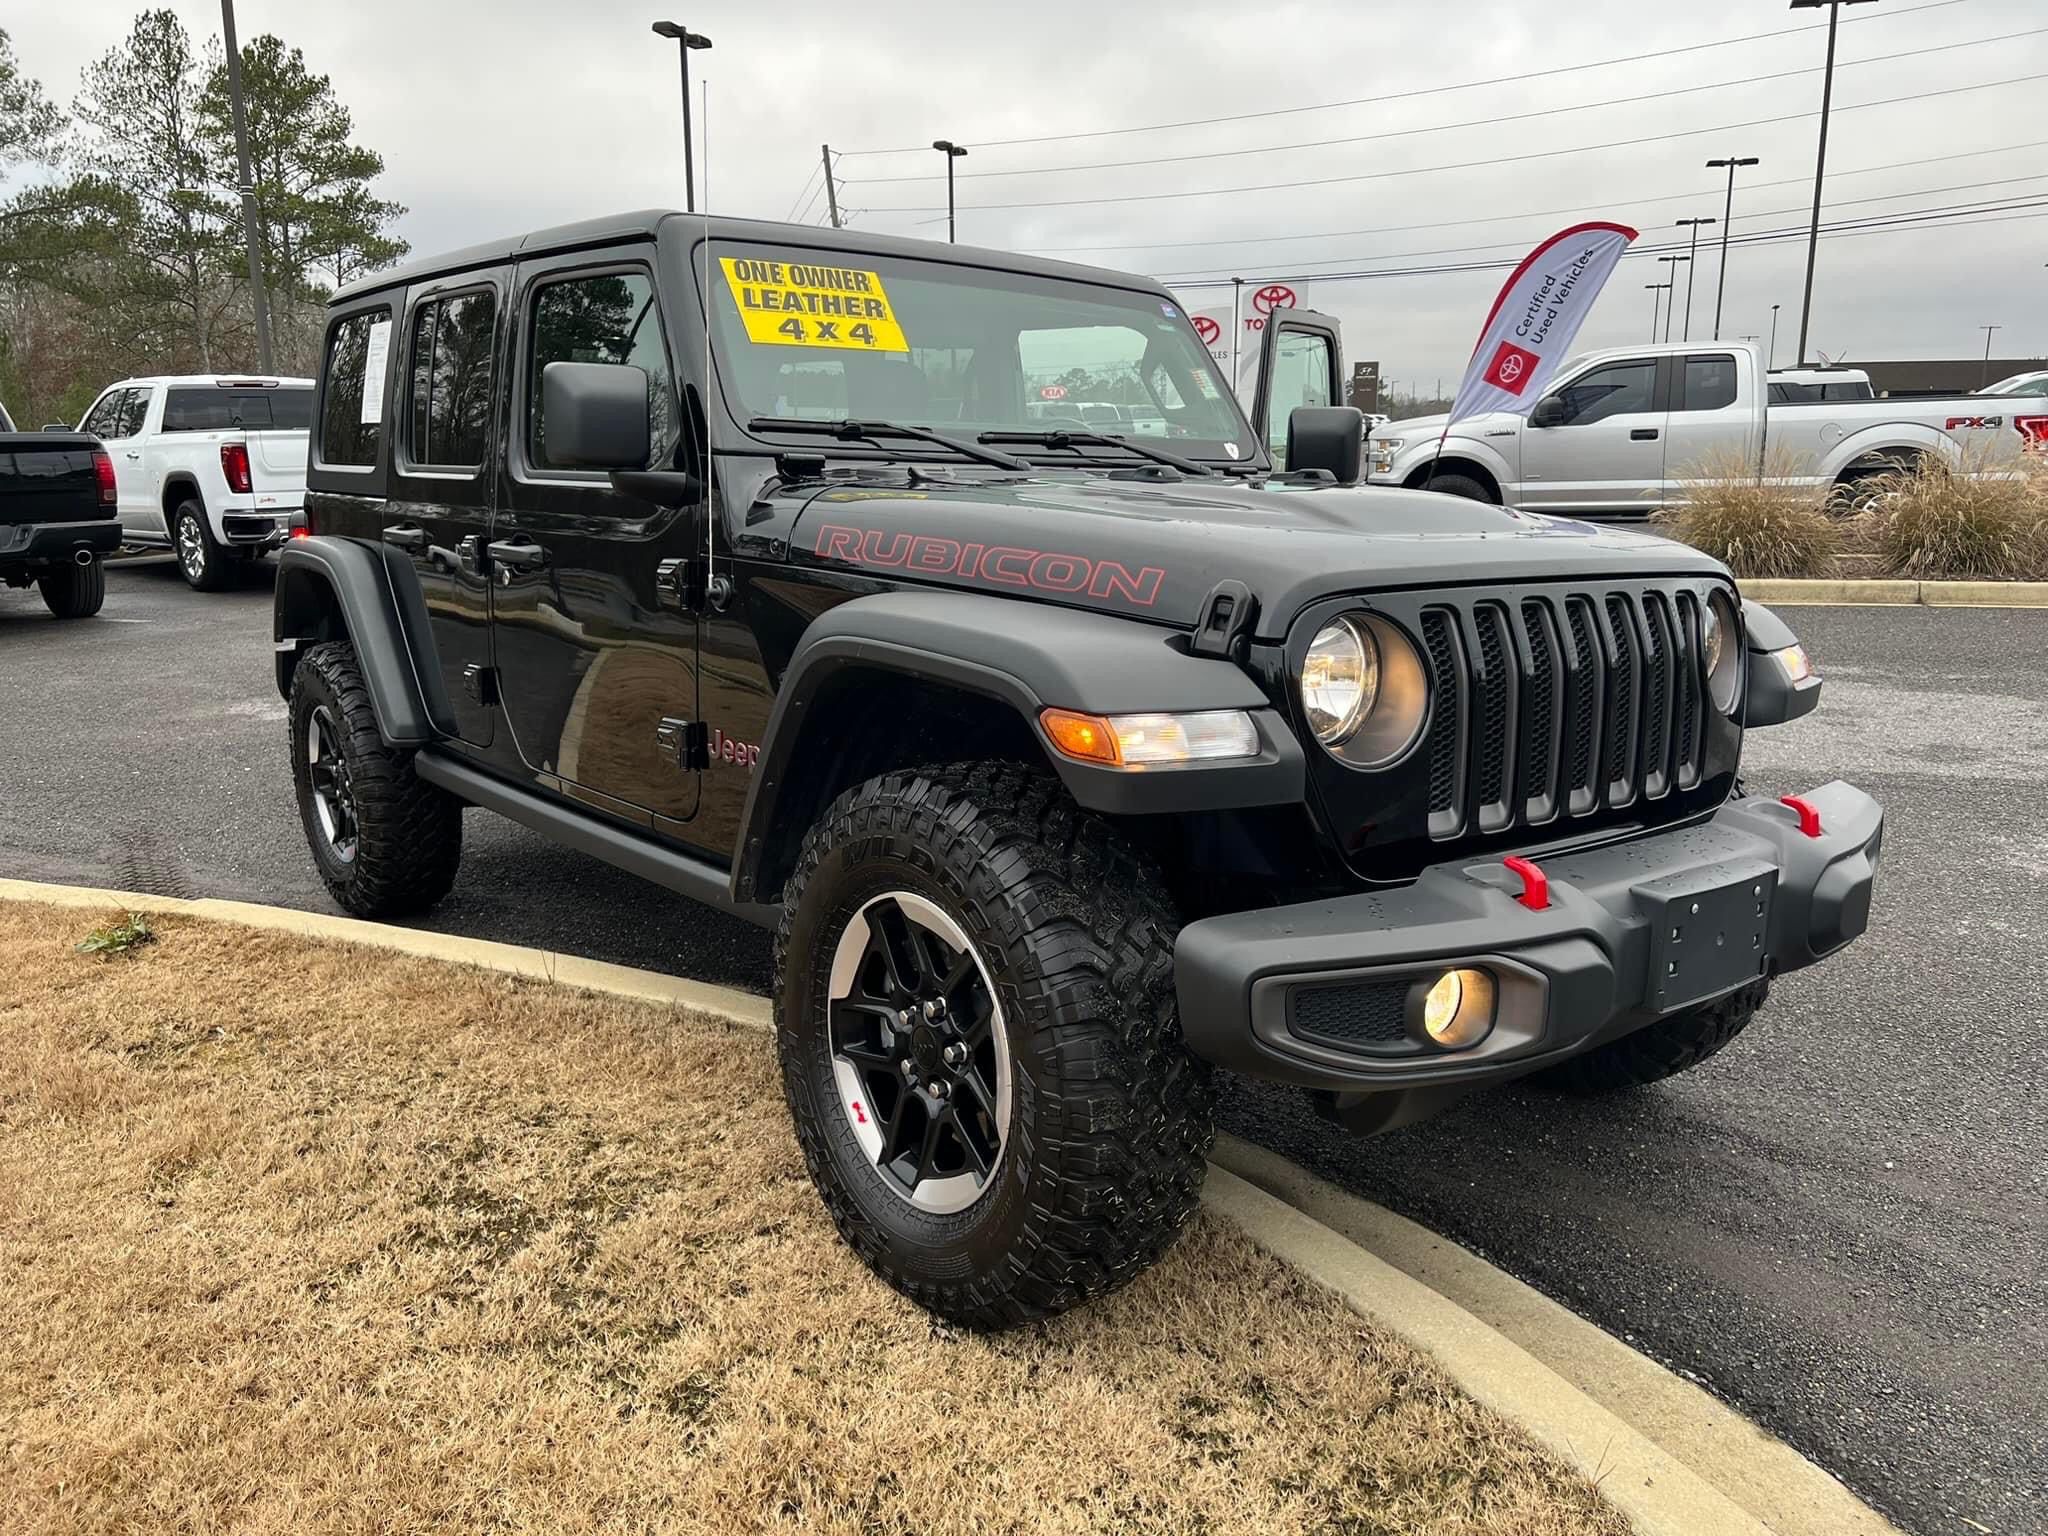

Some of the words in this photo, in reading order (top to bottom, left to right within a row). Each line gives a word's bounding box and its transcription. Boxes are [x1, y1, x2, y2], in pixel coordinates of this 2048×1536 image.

[734, 260, 783, 285] ONE
[789, 264, 873, 293] OWNER
[1530, 308, 1558, 344] Used
[1552, 249, 1595, 305] Vehicles
[742, 287, 888, 320] LEATHER
[1516, 274, 1557, 336] Certified
[1945, 416, 2003, 430] FX4
[814, 524, 1166, 606] RUBICON
[708, 729, 761, 774] Jeep
